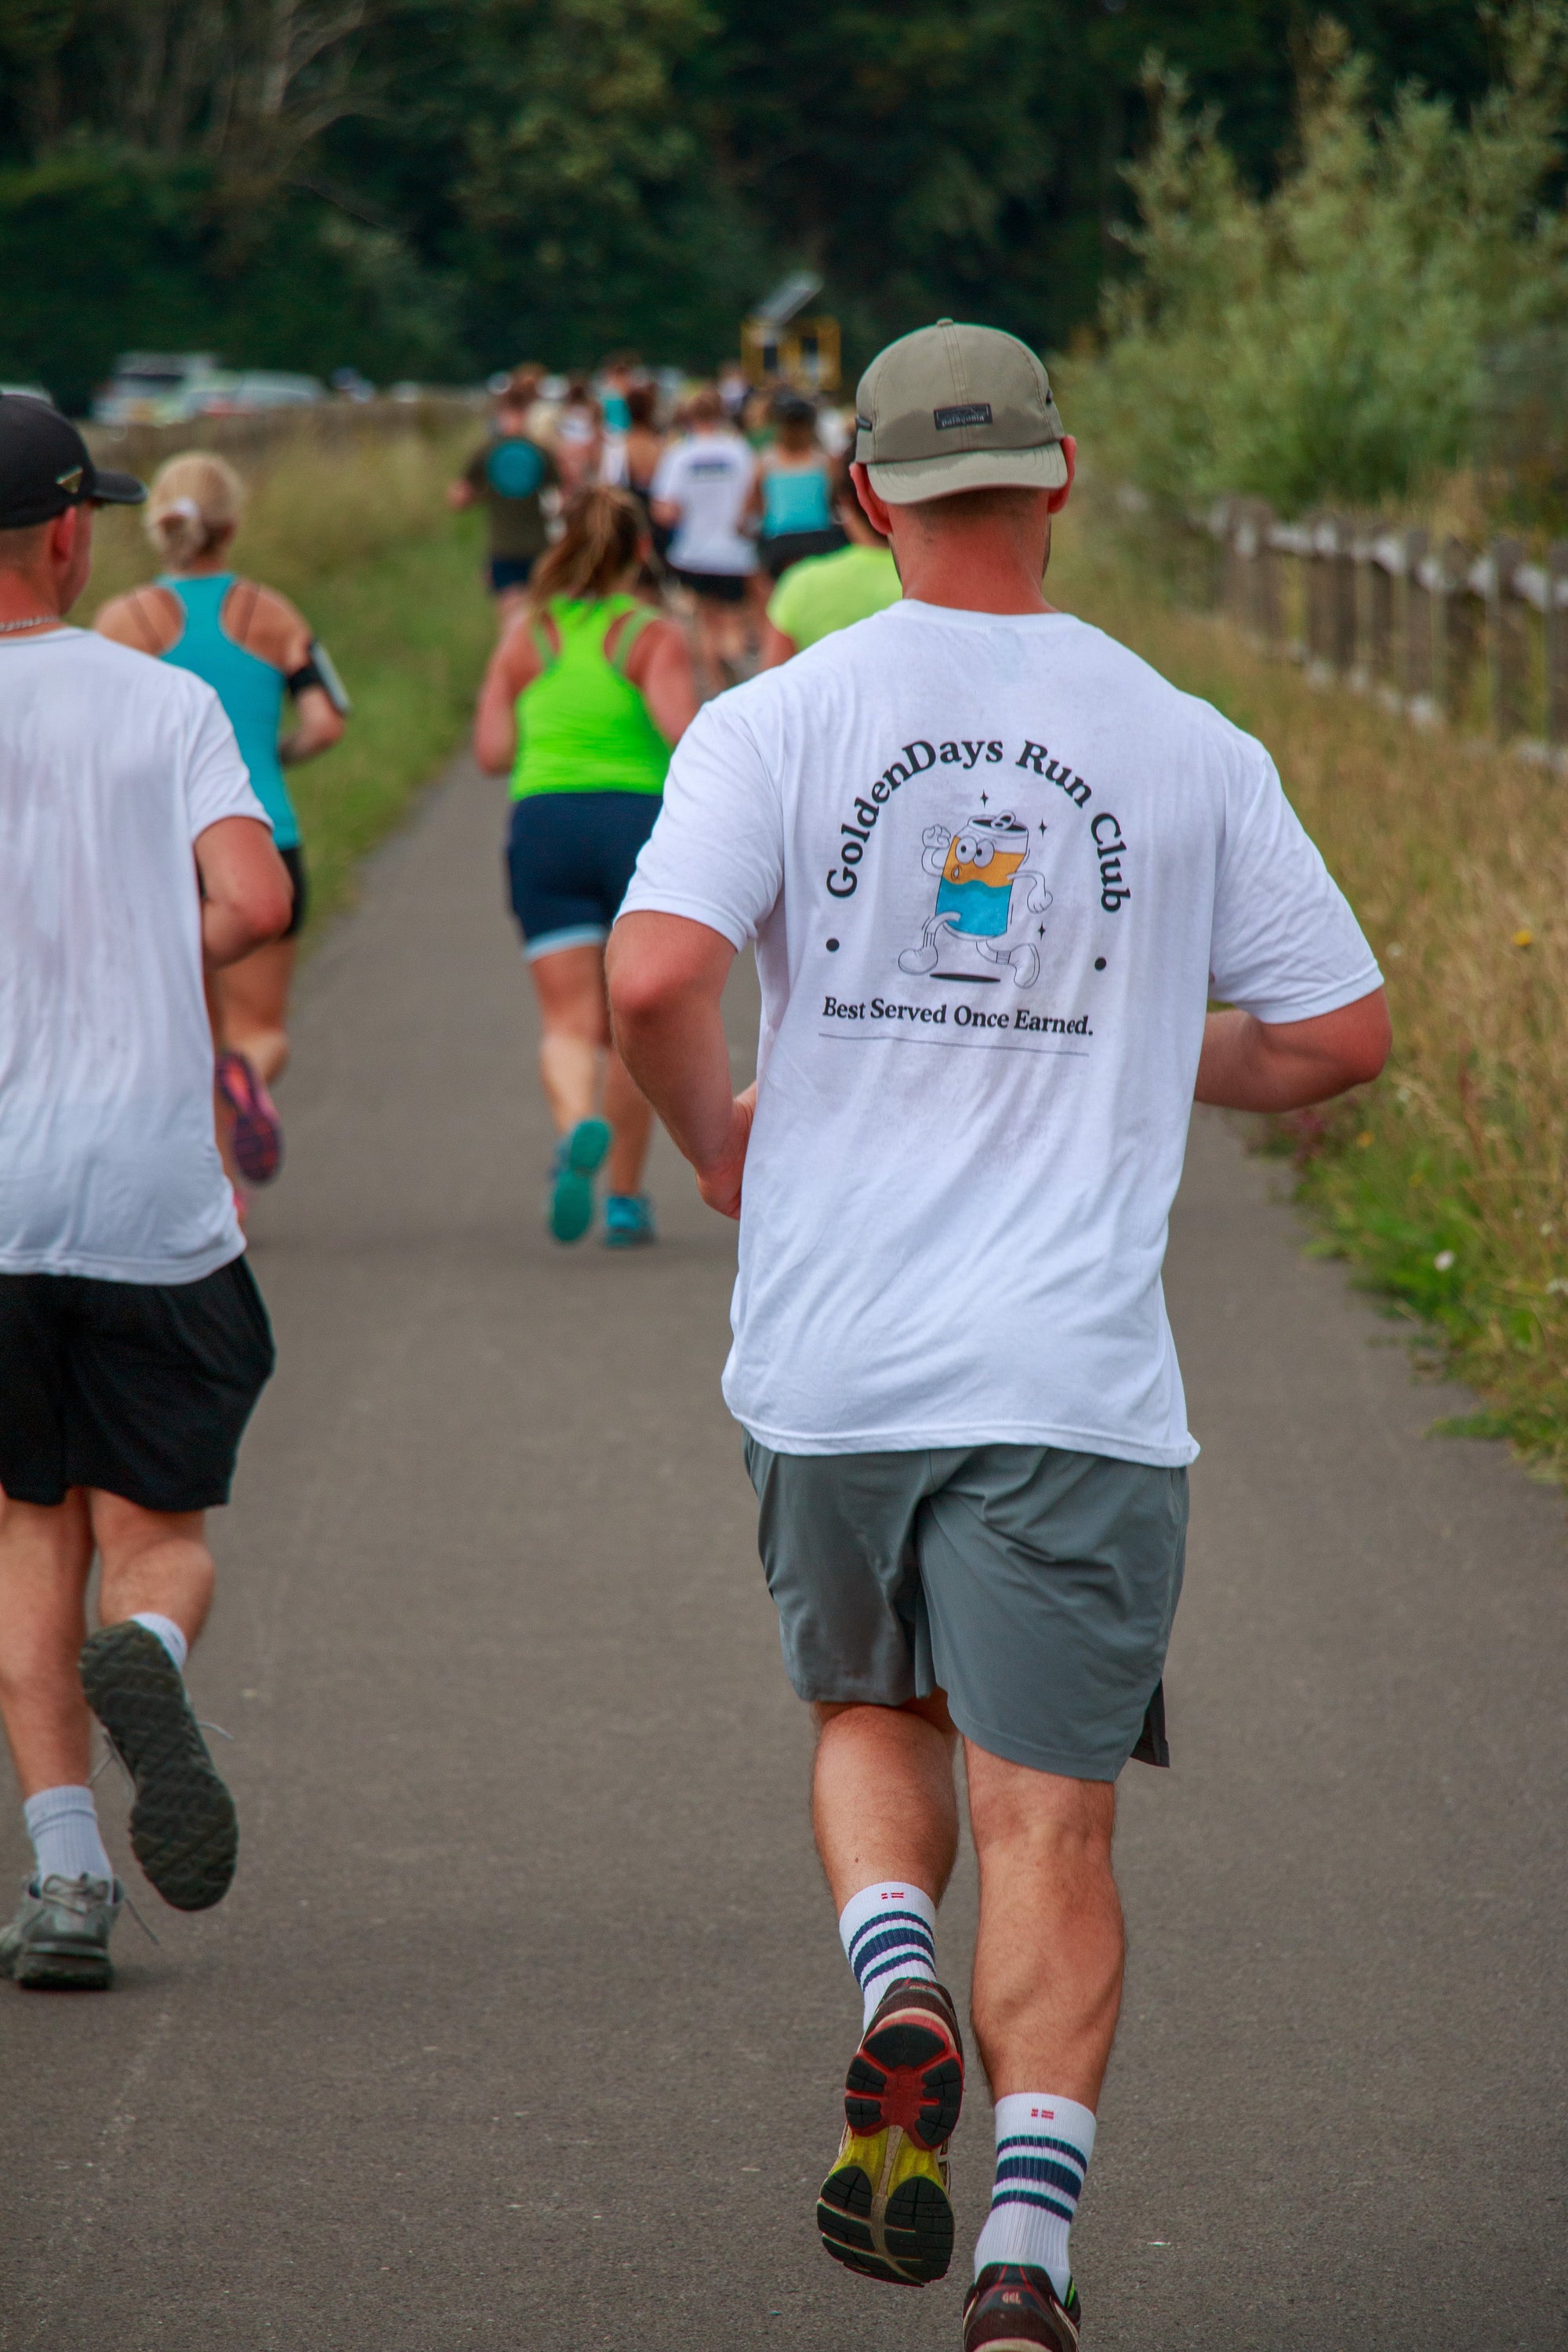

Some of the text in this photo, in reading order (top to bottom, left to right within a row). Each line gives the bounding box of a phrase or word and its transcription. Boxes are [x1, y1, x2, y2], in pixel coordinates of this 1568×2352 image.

[826, 739, 1131, 913] GoldenDays Run Club
[822, 996, 1094, 1036] Best Served Once Earned.
